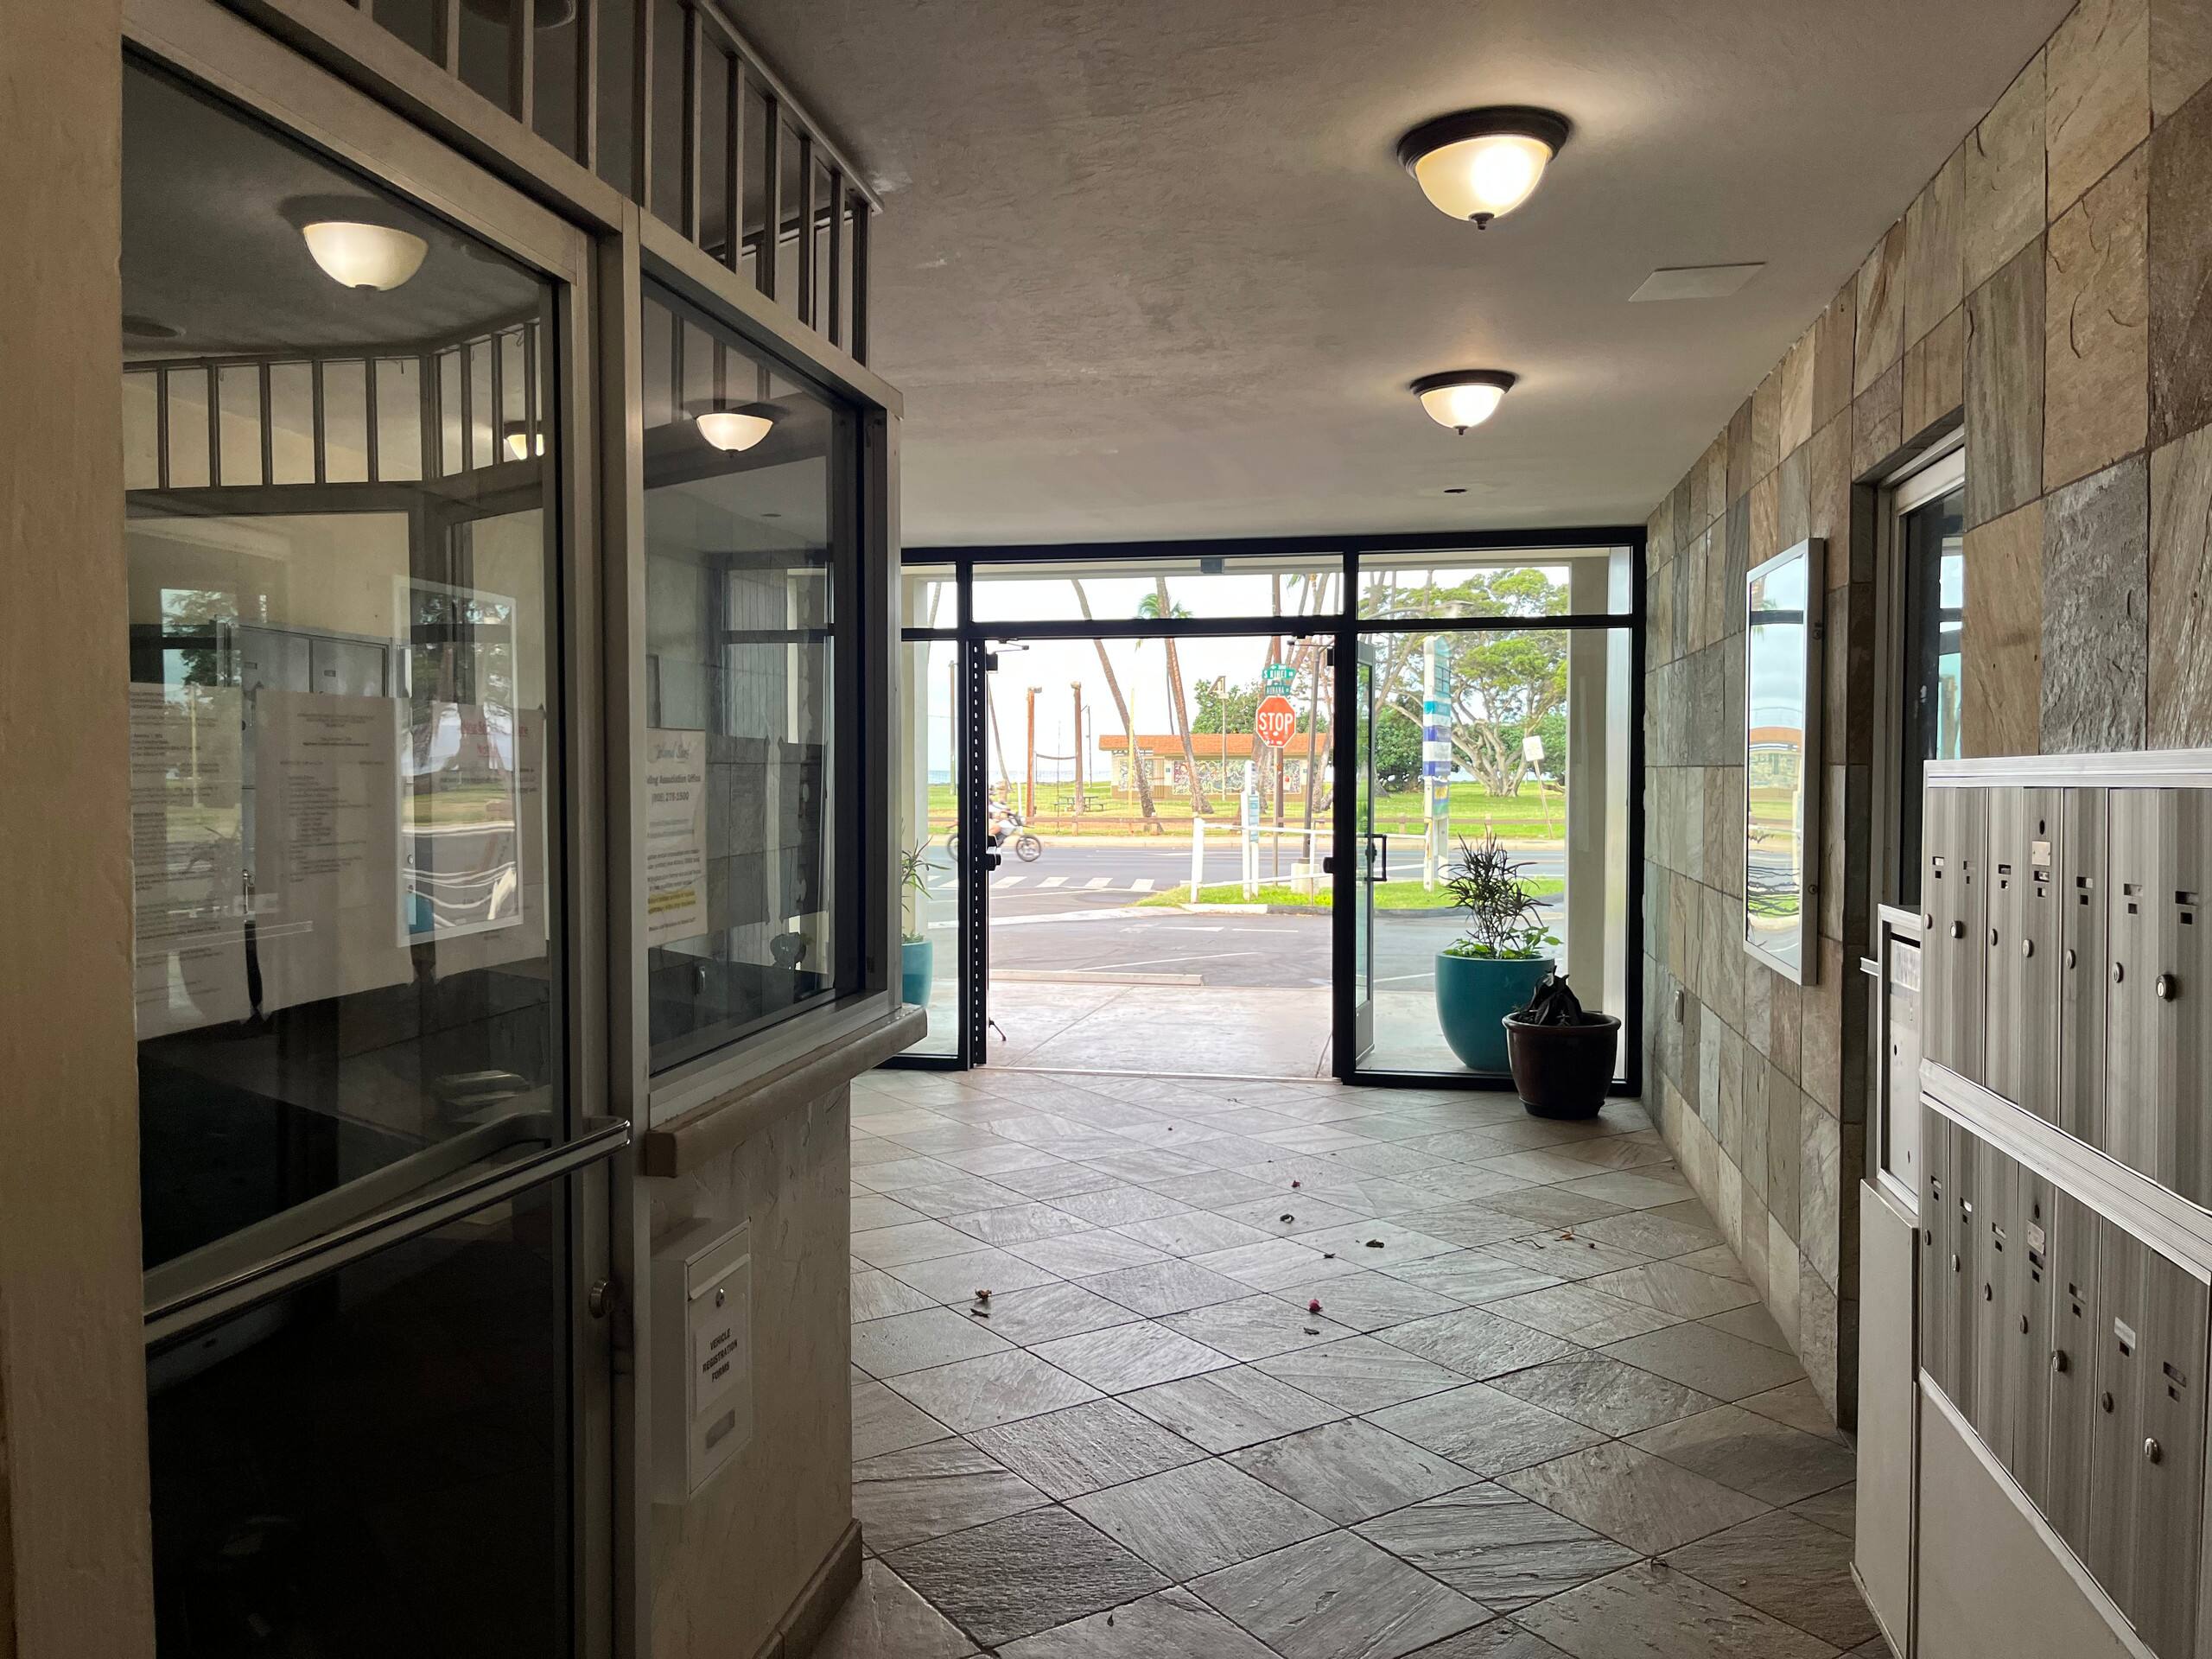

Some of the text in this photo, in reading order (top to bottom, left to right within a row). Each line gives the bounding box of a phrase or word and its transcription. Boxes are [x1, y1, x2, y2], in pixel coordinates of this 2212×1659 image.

[1263, 670, 1268, 678] S
[1259, 712, 1294, 732] STOP
[710, 1327, 731, 1351] VEHICLE
[702, 1339, 738, 1374] REGISTRATION
[712, 1361, 730, 1383] FORMS
